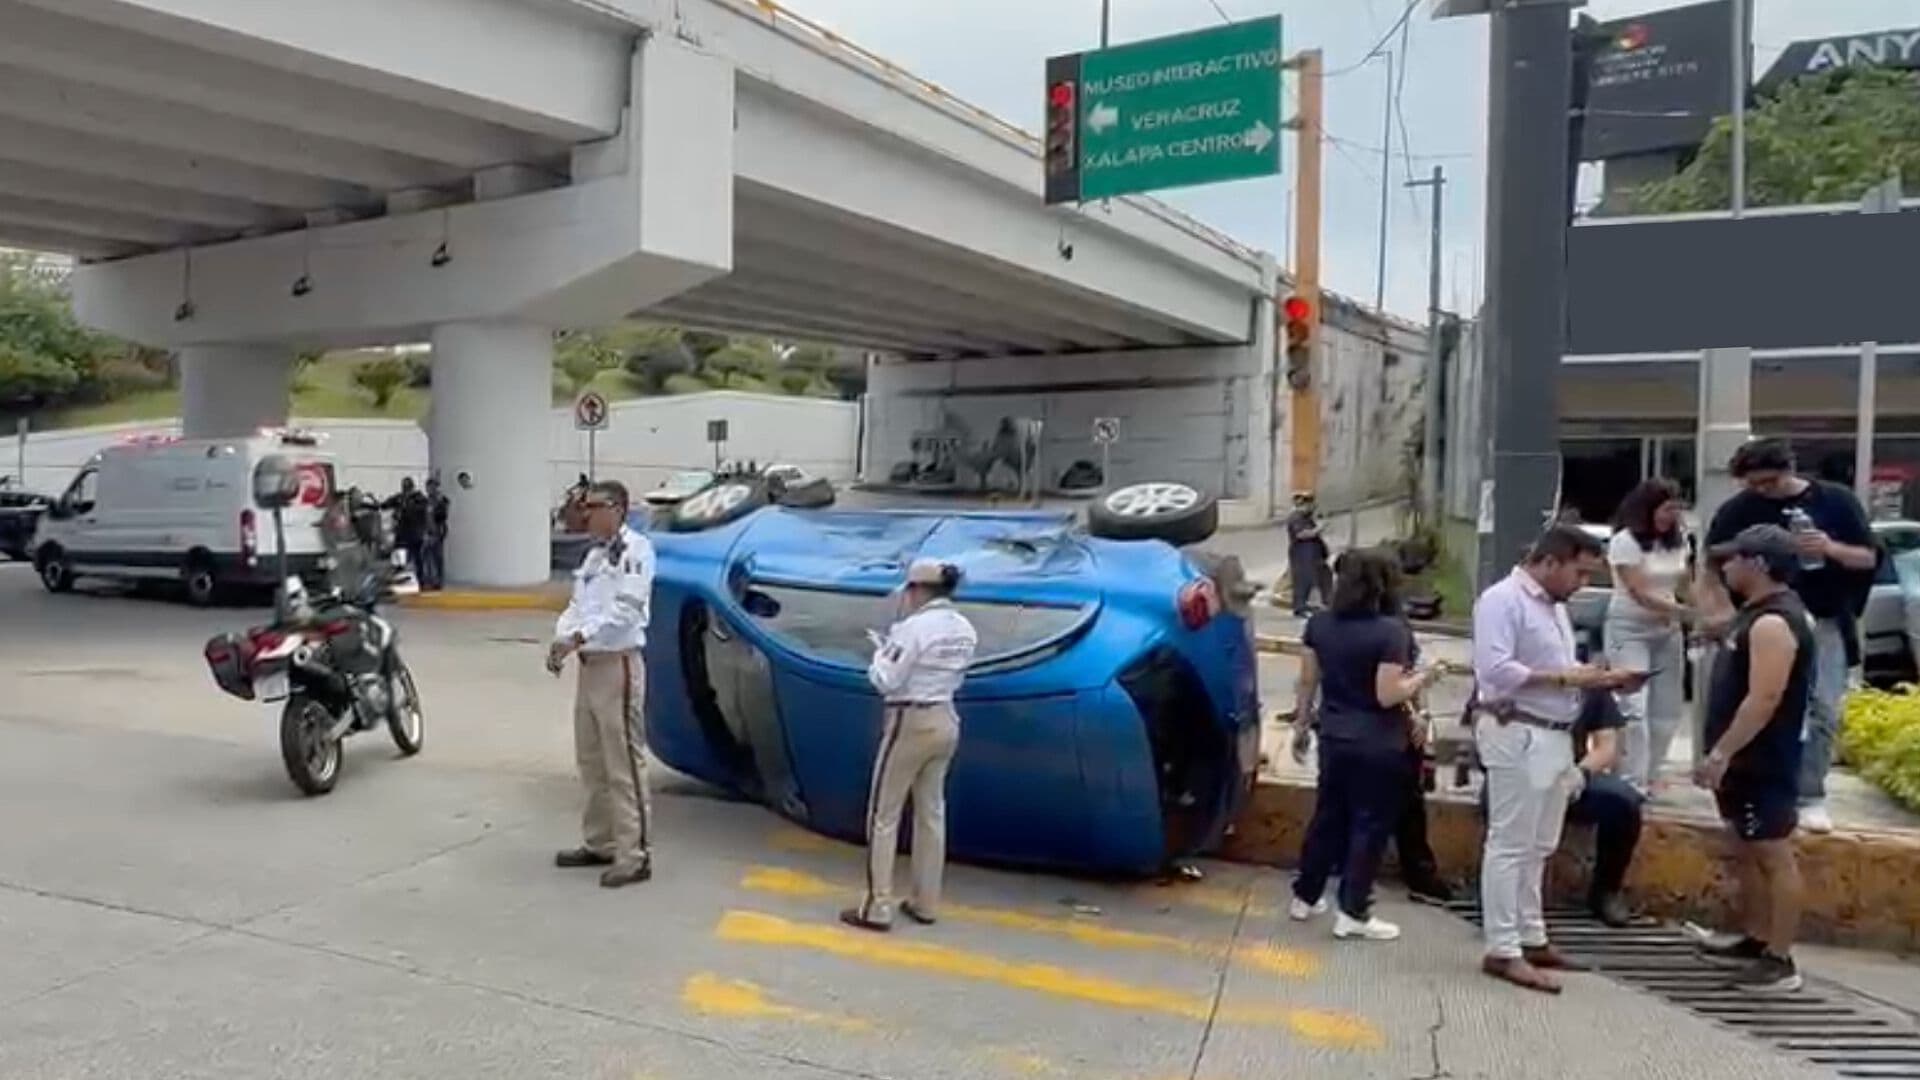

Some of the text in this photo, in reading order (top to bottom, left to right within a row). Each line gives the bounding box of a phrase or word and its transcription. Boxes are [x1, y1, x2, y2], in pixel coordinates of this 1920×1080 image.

[1084, 52, 1277, 96] MUSEO INTERACTIVO
[1131, 99, 1241, 130] VERACRUZ
[1083, 133, 1245, 169] XALAPA CENTRO
